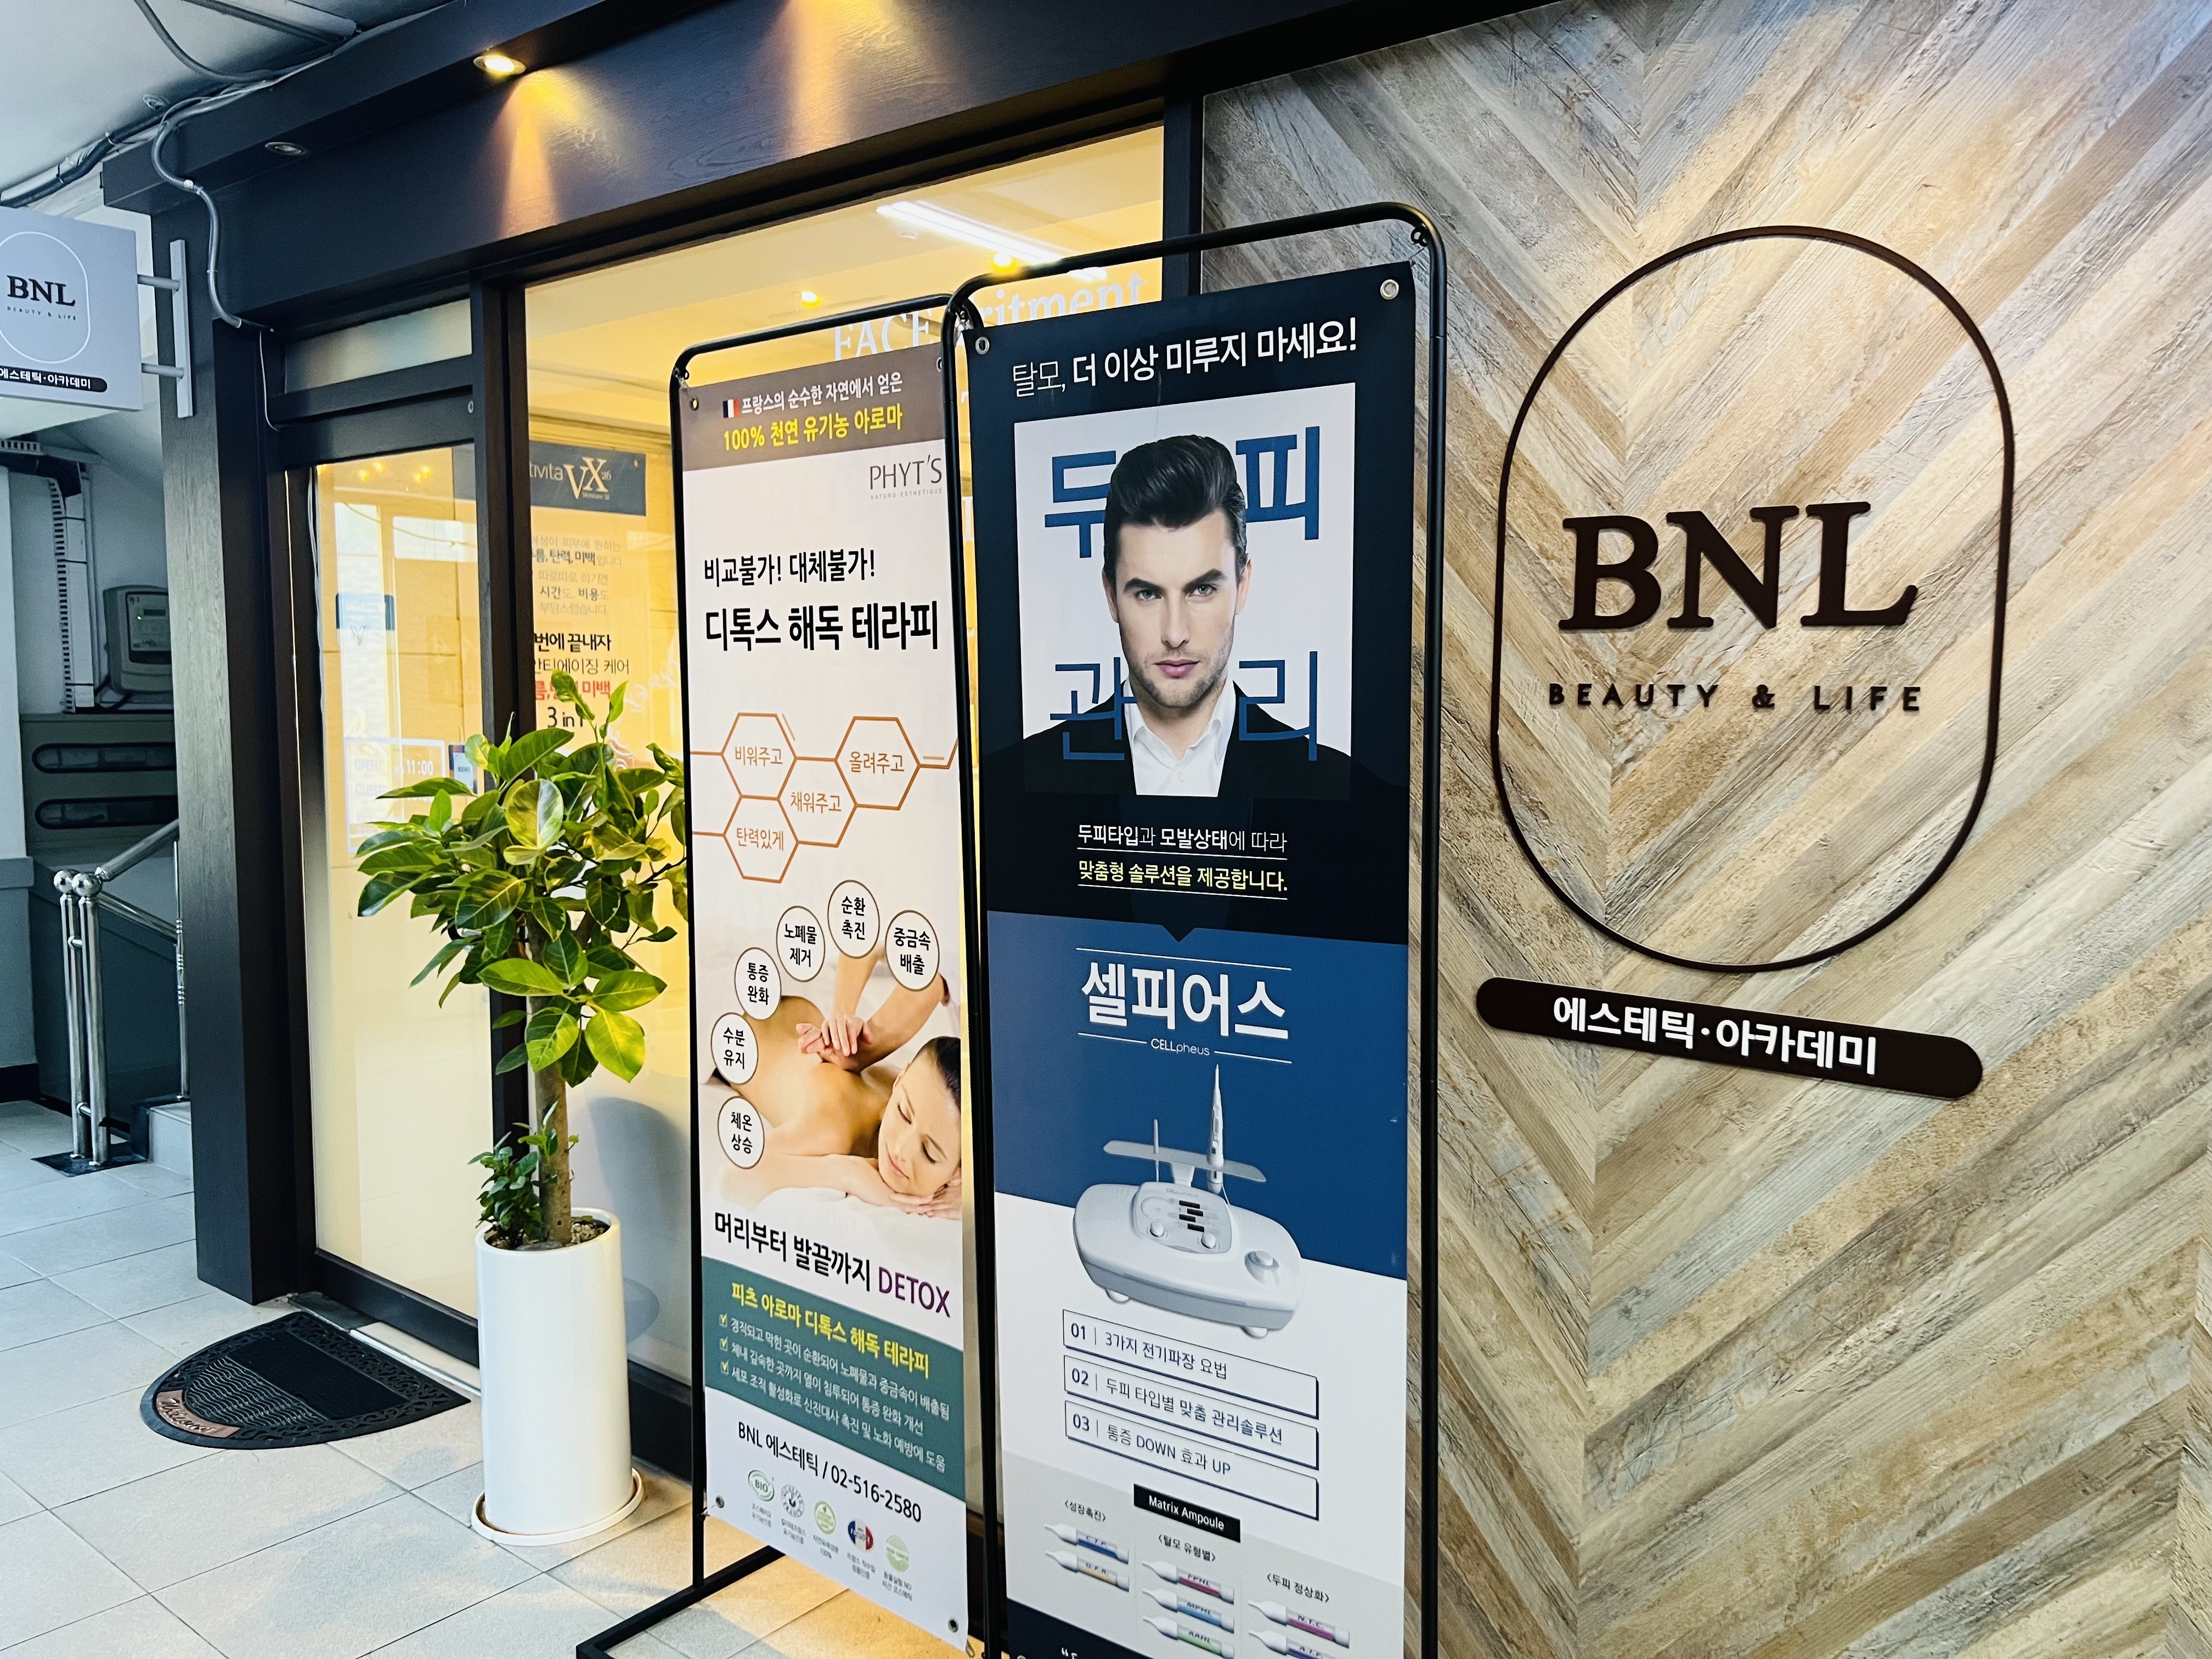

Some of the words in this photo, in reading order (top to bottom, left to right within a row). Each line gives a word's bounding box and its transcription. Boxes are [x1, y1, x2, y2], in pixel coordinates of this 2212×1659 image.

[7, 275, 76, 306] BNL
[7, 306, 41, 315] BEAUTY
[1013, 361, 1065, 398] 탈모,
[1073, 353, 1096, 386] 더
[1104, 345, 1158, 382] 이상
[1166, 332, 1248, 373] 미루지
[1257, 317, 1357, 363] 마세요!
[741, 391, 785, 415] 프랑스의
[788, 385, 823, 409] 순수한
[825, 376, 873, 404] 자연에서
[877, 371, 903, 394] 얻은
[724, 425, 765, 452] 100%
[770, 417, 799, 448] 천연
[803, 411, 850, 443] 유기농
[854, 403, 903, 435] 아로마
[870, 454, 942, 490] PHYT'S
[704, 554, 781, 588] 비교불가!
[789, 548, 876, 584] 대체불가!
[1558, 501, 1918, 631] BNL
[706, 607, 781, 652] 디톡스
[788, 604, 844, 651] 해독
[851, 600, 938, 650] 테라피
[568, 634, 611, 652] 끝내자
[603, 659, 629, 674] 케어
[1549, 683, 1719, 708] BEAUTY
[1752, 684, 1775, 708] &
[1814, 685, 1921, 712] LIFE
[563, 712, 574, 727] in
[735, 745, 783, 767] 비워주고
[849, 751, 905, 774] 올려주고
[790, 791, 842, 814] 채워주고
[736, 827, 784, 851] 탄력있게
[1077, 825, 1156, 847] 두피타입과
[1160, 828, 1245, 850] 모발상태에
[1251, 832, 1288, 853] 따라
[1079, 860, 1124, 882] 맞춤형
[1128, 864, 1192, 887] 솔루션을
[1197, 867, 1288, 892] 제공합니다.
[841, 896, 866, 916] 순환
[784, 923, 817, 945] 노폐물
[841, 919, 866, 940] 촉진
[893, 927, 931, 951] 중금속
[747, 962, 769, 983] 통증
[789, 949, 812, 968] 제거
[900, 953, 925, 975] 배출
[747, 985, 769, 1006] 완화
[1081, 962, 1289, 1040] 셀피어스
[723, 1027, 746, 1047] 수분
[1151, 1038, 1210, 1056] CELLpheus
[1553, 996, 1877, 1077] 에스테틱·아카데미
[724, 1049, 746, 1070] 유지
[730, 1111, 752, 1131] 체온
[731, 1134, 753, 1154] 상승
[715, 1212, 787, 1262] 머리부터
[794, 1235, 870, 1291] 발끝까지
[879, 1266, 951, 1318] DETOX
[731, 1282, 758, 1308] 피츠
[761, 1294, 801, 1328] 아로마
[805, 1310, 847, 1344] 디톡스
[850, 1326, 880, 1358] 해독
[884, 1340, 930, 1379] 테라피
[1070, 1323, 1086, 1340] 01
[1105, 1331, 1137, 1356] 3가지
[1142, 1342, 1195, 1371] 전기파장
[1200, 1357, 1227, 1380] 요법
[731, 1317, 764, 1342] 경직되고
[765, 1331, 782, 1351] 막힌
[784, 1339, 801, 1359] 곳이
[803, 1347, 838, 1374] 순환되어
[840, 1362, 877, 1390] 노폐물과
[879, 1377, 918, 1407] 중금속이
[920, 1394, 949, 1421] 배출됨
[731, 1342, 748, 1362] 체내
[750, 1350, 775, 1373] 깊숙한
[776, 1360, 802, 1384] 곳까지
[804, 1372, 821, 1393] 열이
[823, 1380, 859, 1409] 침투되어
[862, 1396, 880, 1418] 통증
[883, 1405, 902, 1427] 완화
[904, 1414, 923, 1437] 개선
[731, 1367, 748, 1384] 세포
[750, 1373, 766, 1394] 조직
[769, 1381, 803, 1408] 활성화로
[804, 1397, 839, 1425] 신진대사
[841, 1413, 859, 1435] 촉진
[862, 1421, 871, 1440] 및
[873, 1427, 892, 1449] 노화
[894, 1436, 924, 1463] 예방에
[926, 1450, 946, 1474] 도움
[1071, 1368, 1089, 1386] 02
[1106, 1378, 1130, 1400] 두피
[1135, 1388, 1175, 1414] 타입별
[1180, 1398, 1207, 1423] 맞춤
[1211, 1409, 1283, 1446] 관리솔루션
[1073, 1413, 1090, 1432] 03
[1107, 1423, 1132, 1446] 통증
[1136, 1435, 1176, 1459] DOWN
[1180, 1446, 1207, 1471] 효과
[1212, 1458, 1231, 1476] UP
[738, 1421, 762, 1448] BNL
[766, 1434, 819, 1477] 에스테틱
[822, 1461, 828, 1480] /
[831, 1464, 922, 1523] 02-516-2580
[755, 1479, 768, 1492] BIO
[1149, 1495, 1178, 1515] Matrix
[1181, 1507, 1224, 1532] Ampoule
